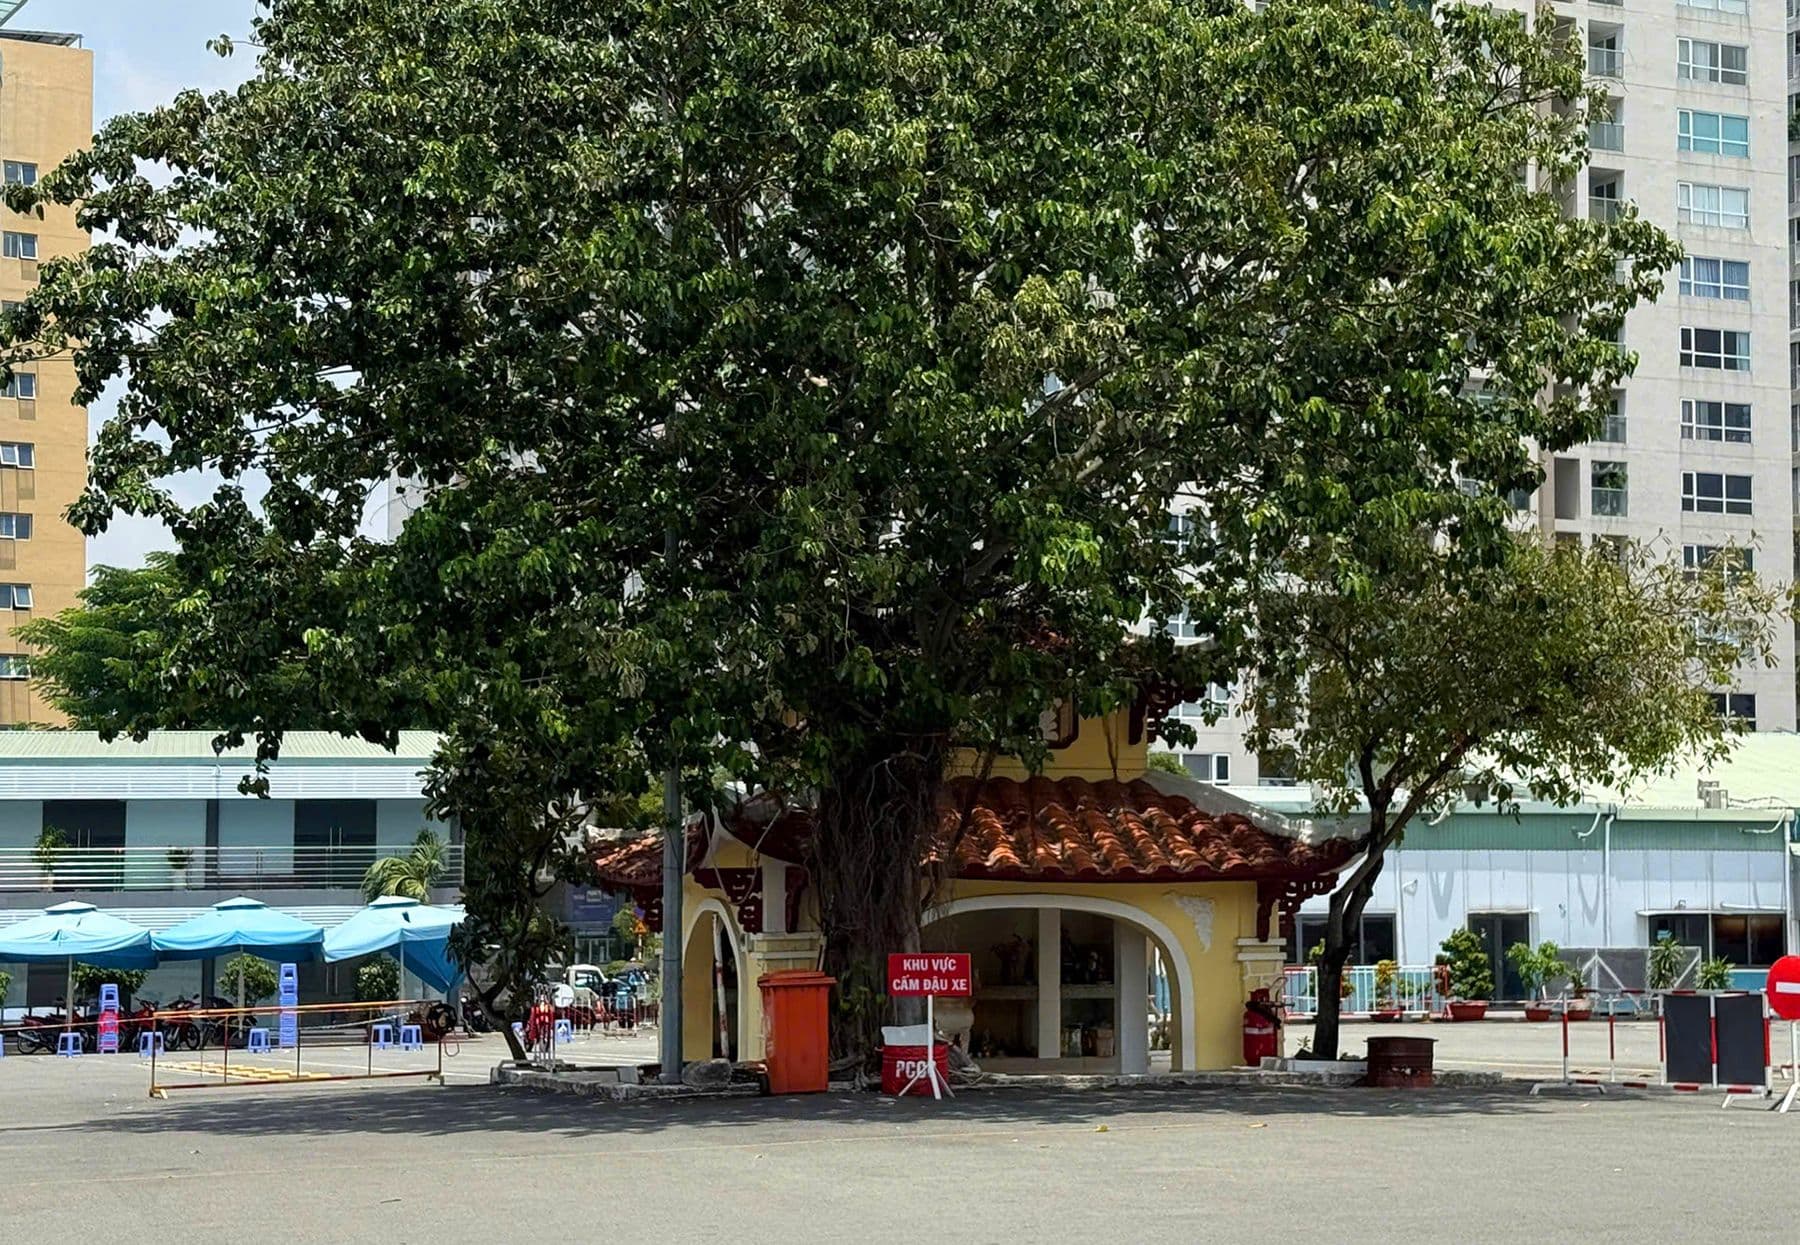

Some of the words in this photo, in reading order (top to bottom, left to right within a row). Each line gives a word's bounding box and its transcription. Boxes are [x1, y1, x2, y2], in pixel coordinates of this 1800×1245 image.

[903, 959, 928, 971] KHU
[931, 956, 957, 974] VỰC
[892, 974, 920, 991] CẤM
[923, 975, 948, 993] ĐẬU
[951, 979, 968, 991] XE
[895, 1060, 937, 1079] PCC
